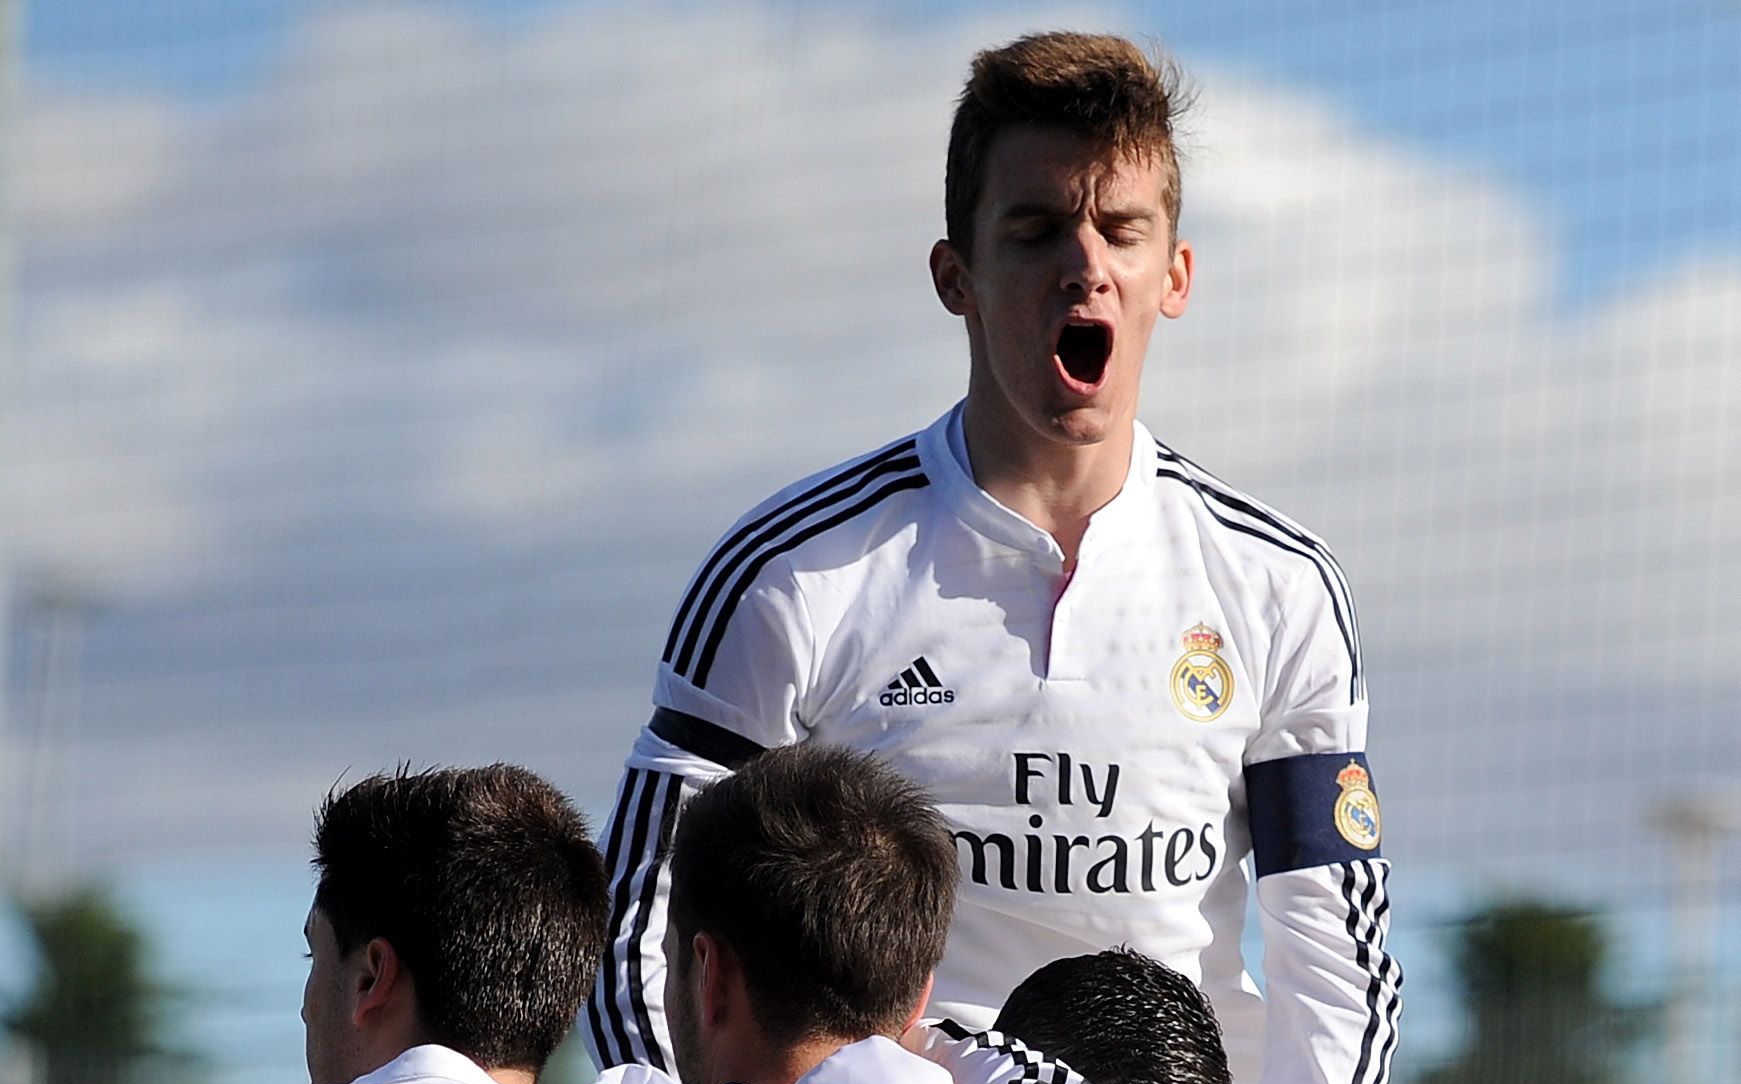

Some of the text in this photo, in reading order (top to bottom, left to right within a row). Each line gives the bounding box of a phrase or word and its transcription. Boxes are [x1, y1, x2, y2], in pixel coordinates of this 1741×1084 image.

[879, 687, 955, 706] adidas
[1013, 752, 1120, 818] Fly
[952, 813, 1217, 894] mirates
